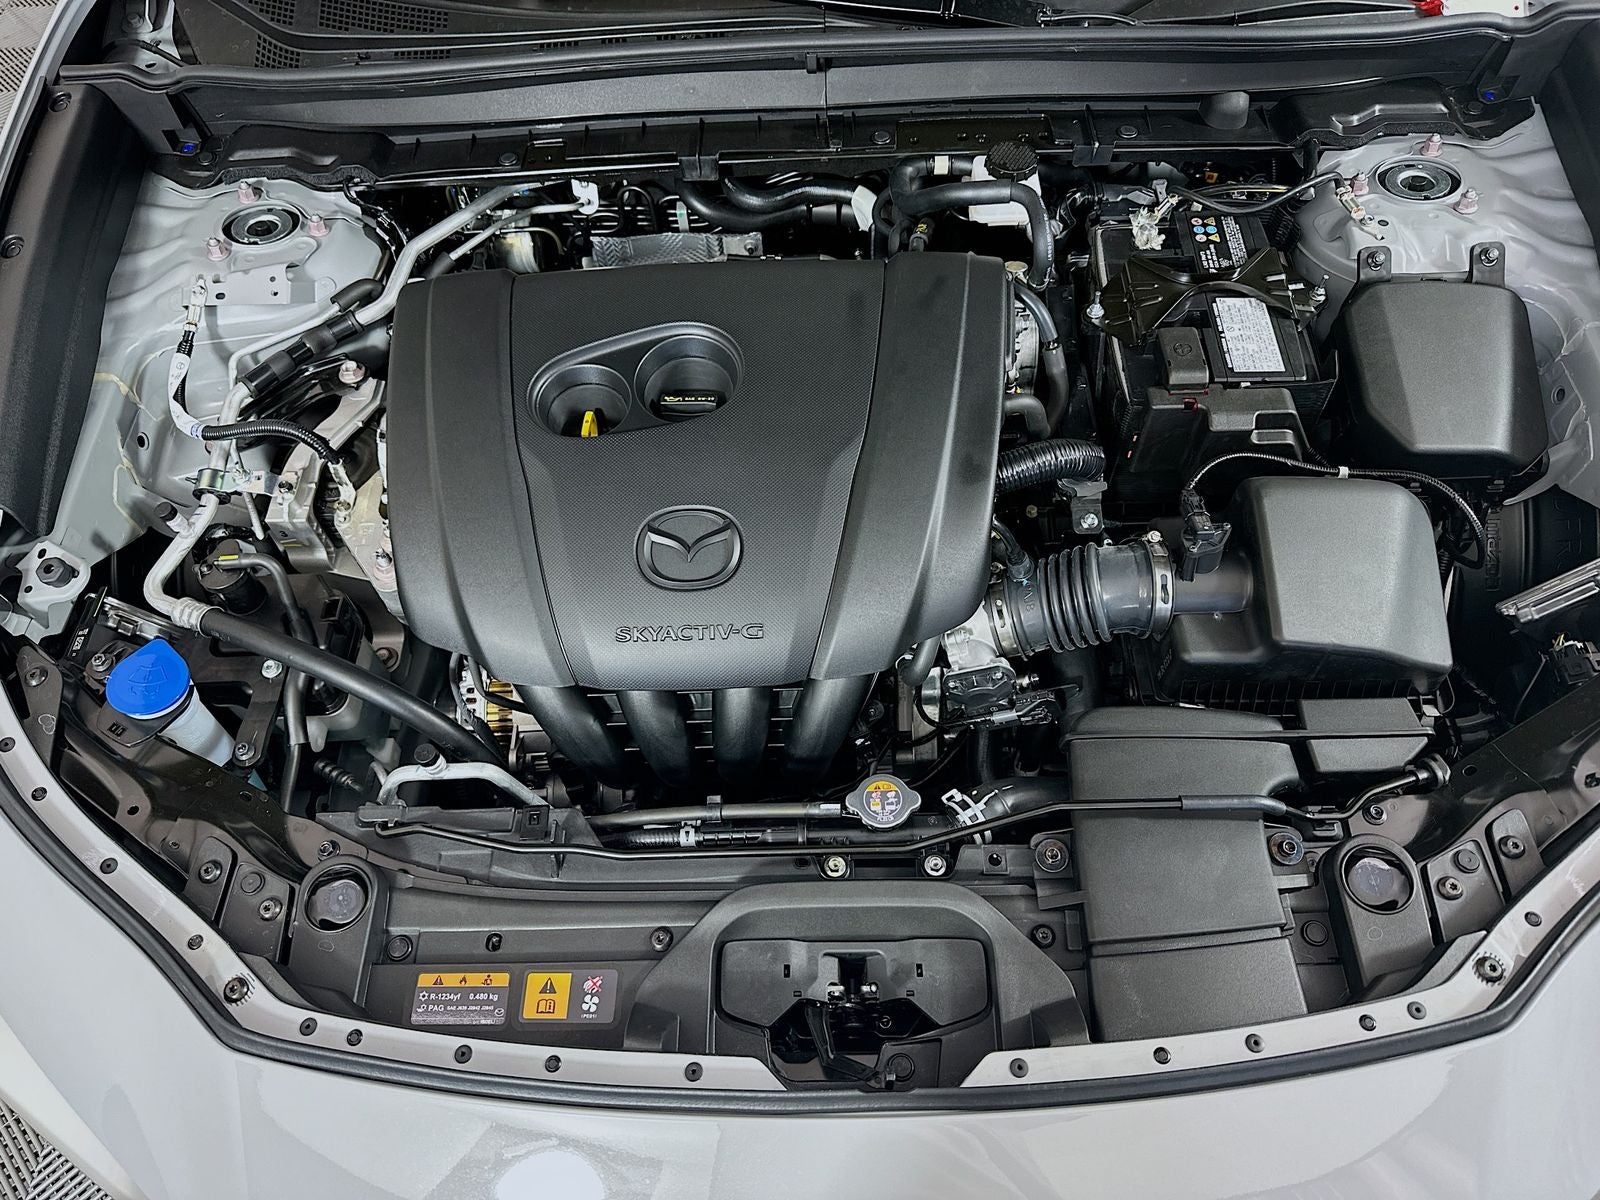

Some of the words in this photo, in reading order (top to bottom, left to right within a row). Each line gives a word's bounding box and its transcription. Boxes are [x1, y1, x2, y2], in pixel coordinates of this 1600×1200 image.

[615, 622, 764, 643] SKYACTIV-G
[429, 992, 461, 1001] R-1234yf
[469, 992, 488, 1000] 0.480
[489, 992, 498, 1001] kg
[428, 1004, 444, 1012] PAG
